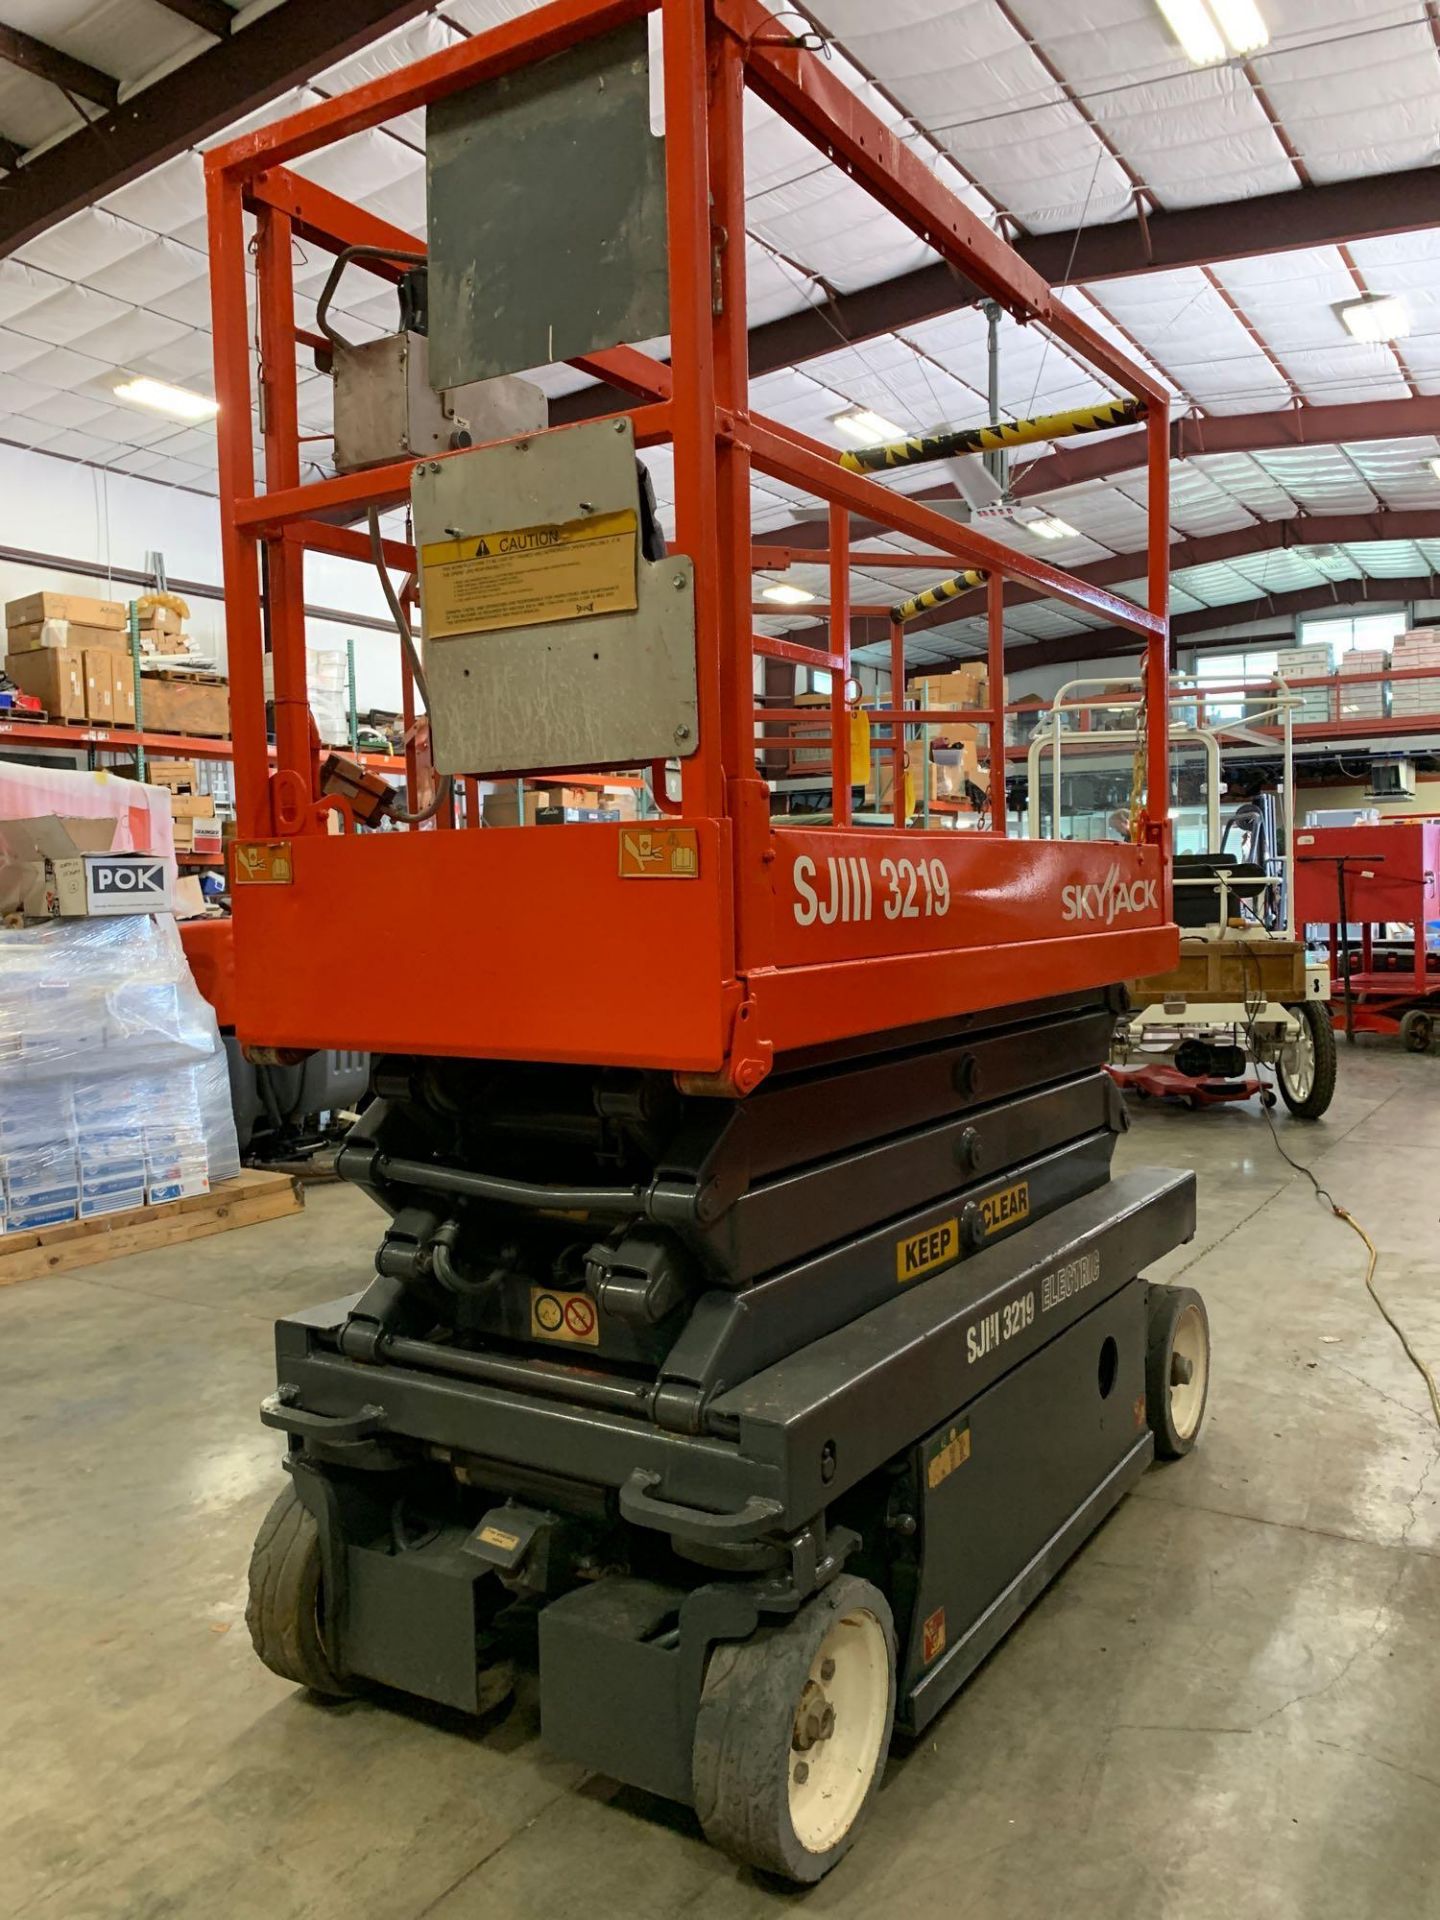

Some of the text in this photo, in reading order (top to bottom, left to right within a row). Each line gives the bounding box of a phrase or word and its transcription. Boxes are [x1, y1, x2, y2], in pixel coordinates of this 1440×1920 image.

[499, 529, 560, 553] CAUTION
[97, 863, 164, 893] POK
[793, 855, 951, 926] SJIII 3219
[1061, 862, 1158, 925] SKYJACK
[905, 1186, 1028, 1272] KEEP CLEAR
[1003, 1290, 1035, 1340] 3219
[1041, 1249, 1100, 1312] ELECTRIC
